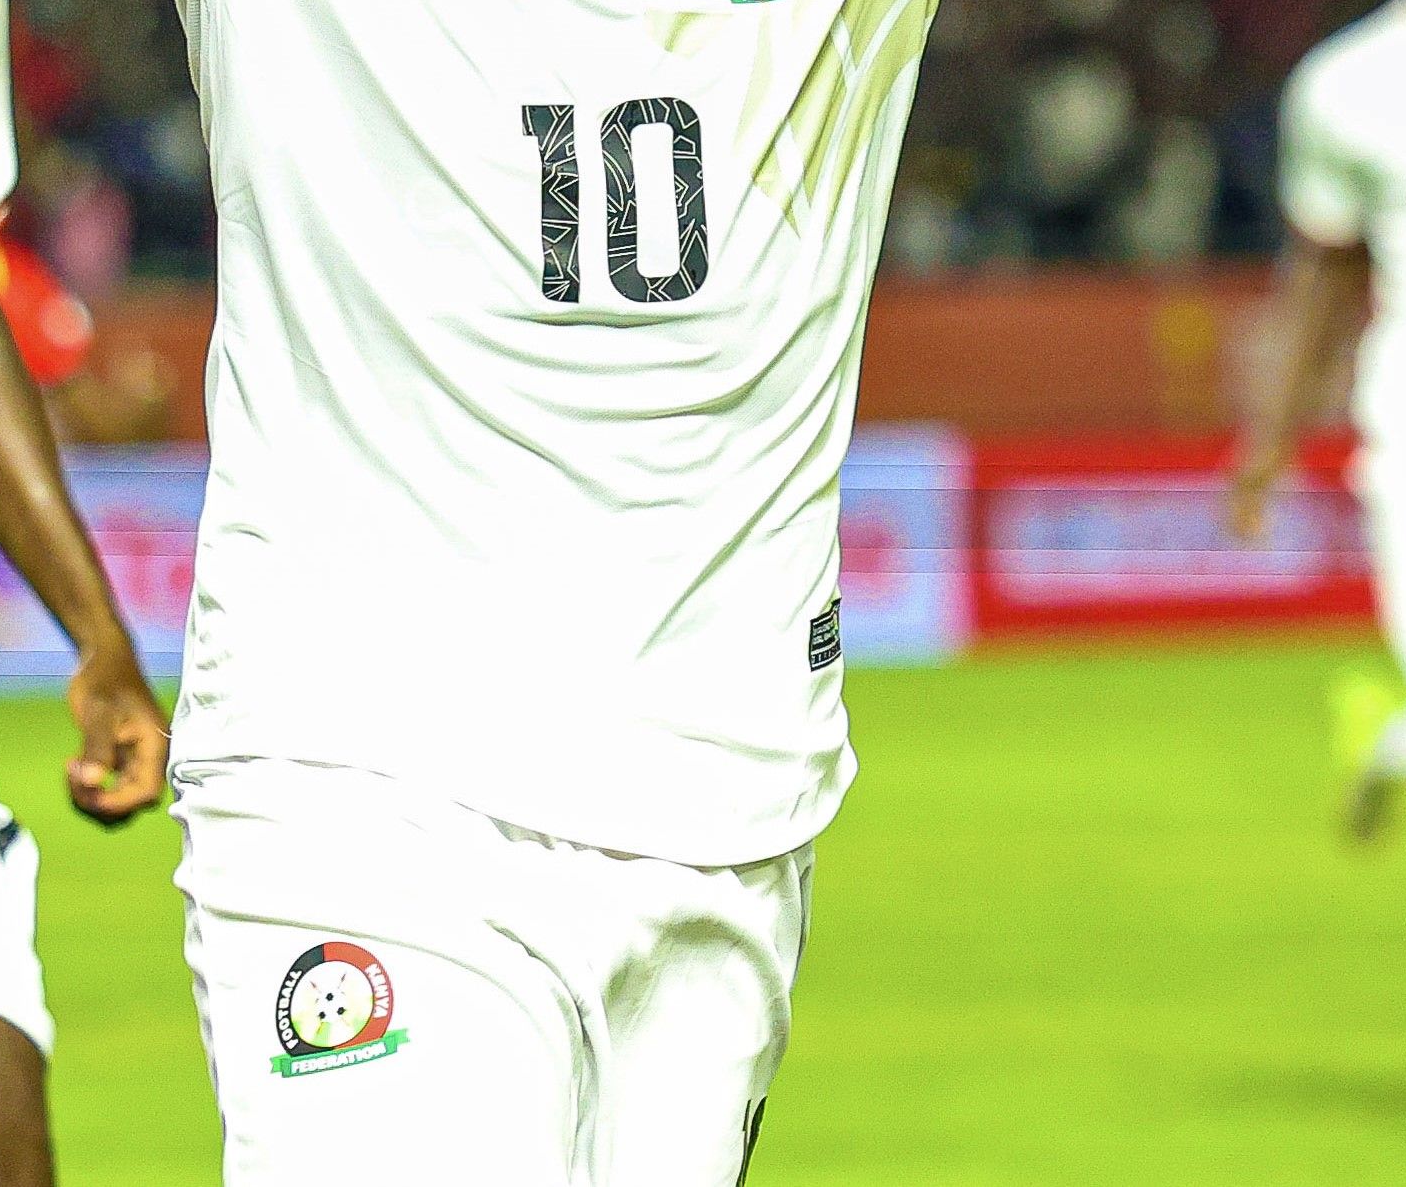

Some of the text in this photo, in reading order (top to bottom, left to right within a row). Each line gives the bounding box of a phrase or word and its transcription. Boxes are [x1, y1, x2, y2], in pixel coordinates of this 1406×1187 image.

[521, 96, 710, 304] 10
[277, 968, 304, 1050] FOOTBALL
[364, 962, 391, 1019] KENYA
[290, 1041, 388, 1075] FEDERATION
